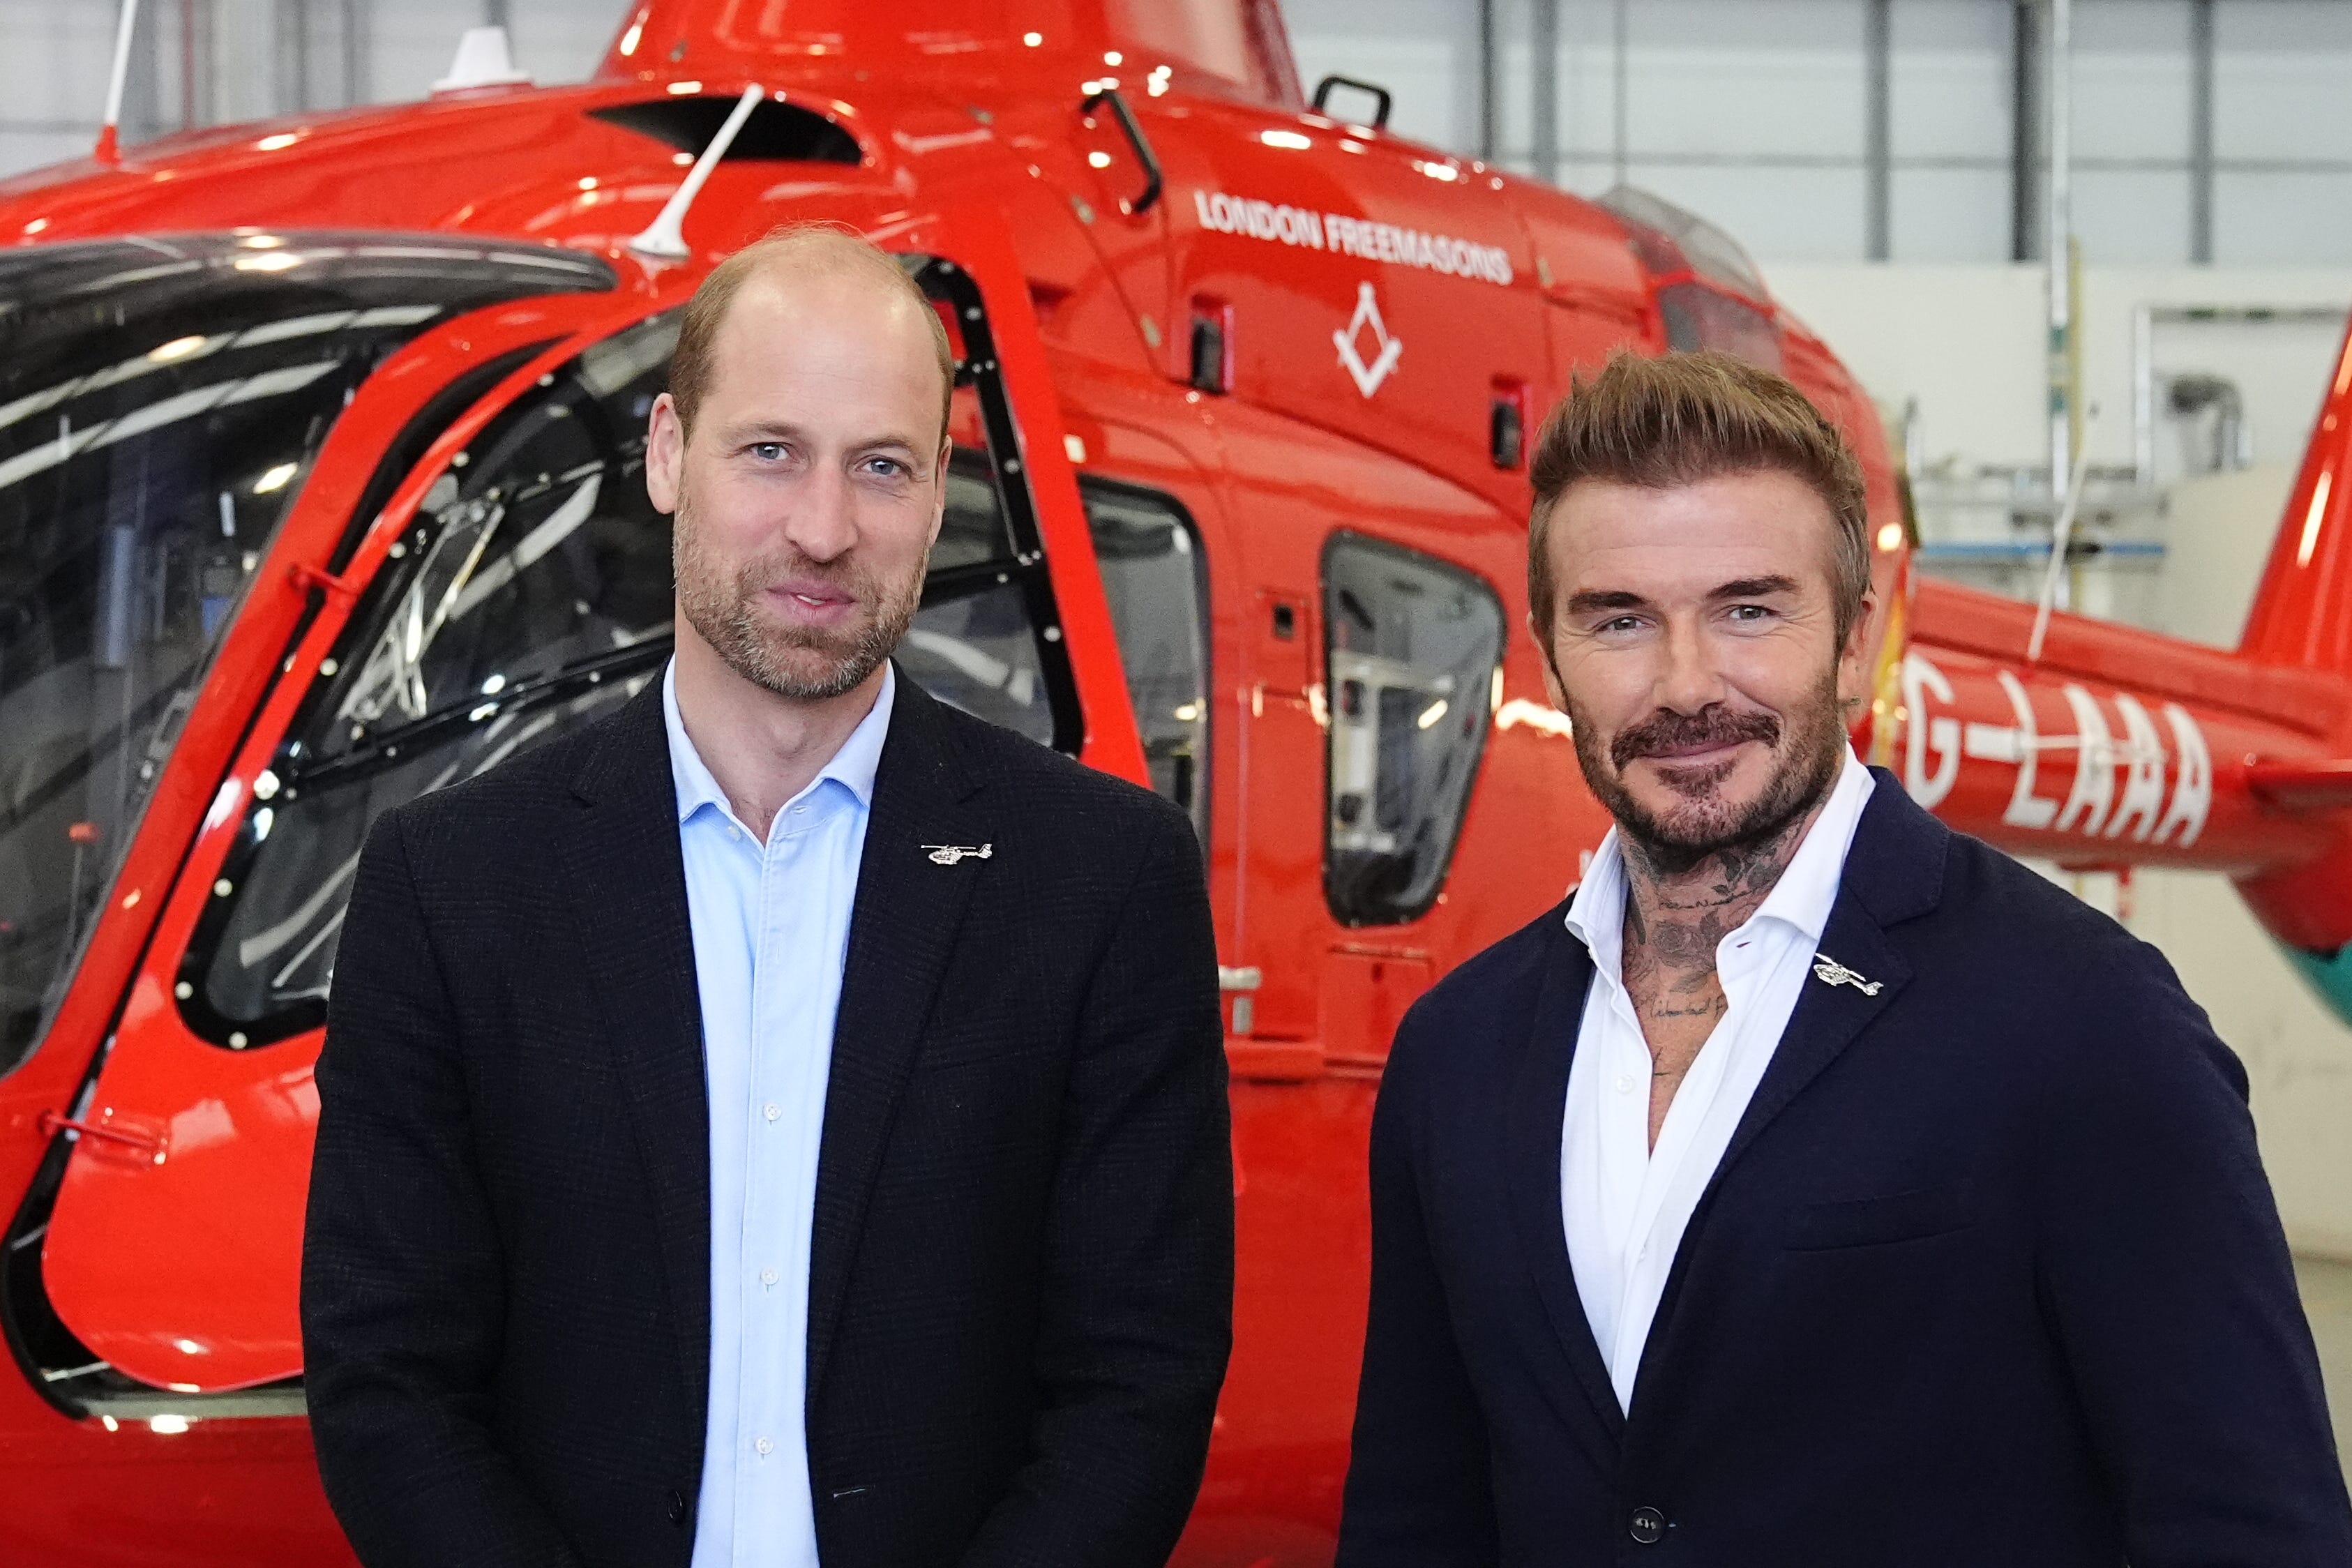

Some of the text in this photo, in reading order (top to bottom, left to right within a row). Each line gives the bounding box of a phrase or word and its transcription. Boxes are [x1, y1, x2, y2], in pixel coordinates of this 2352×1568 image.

[1194, 190, 1513, 286] LONDON FREEMASONS
[1902, 651, 2212, 848] G-LAAA
